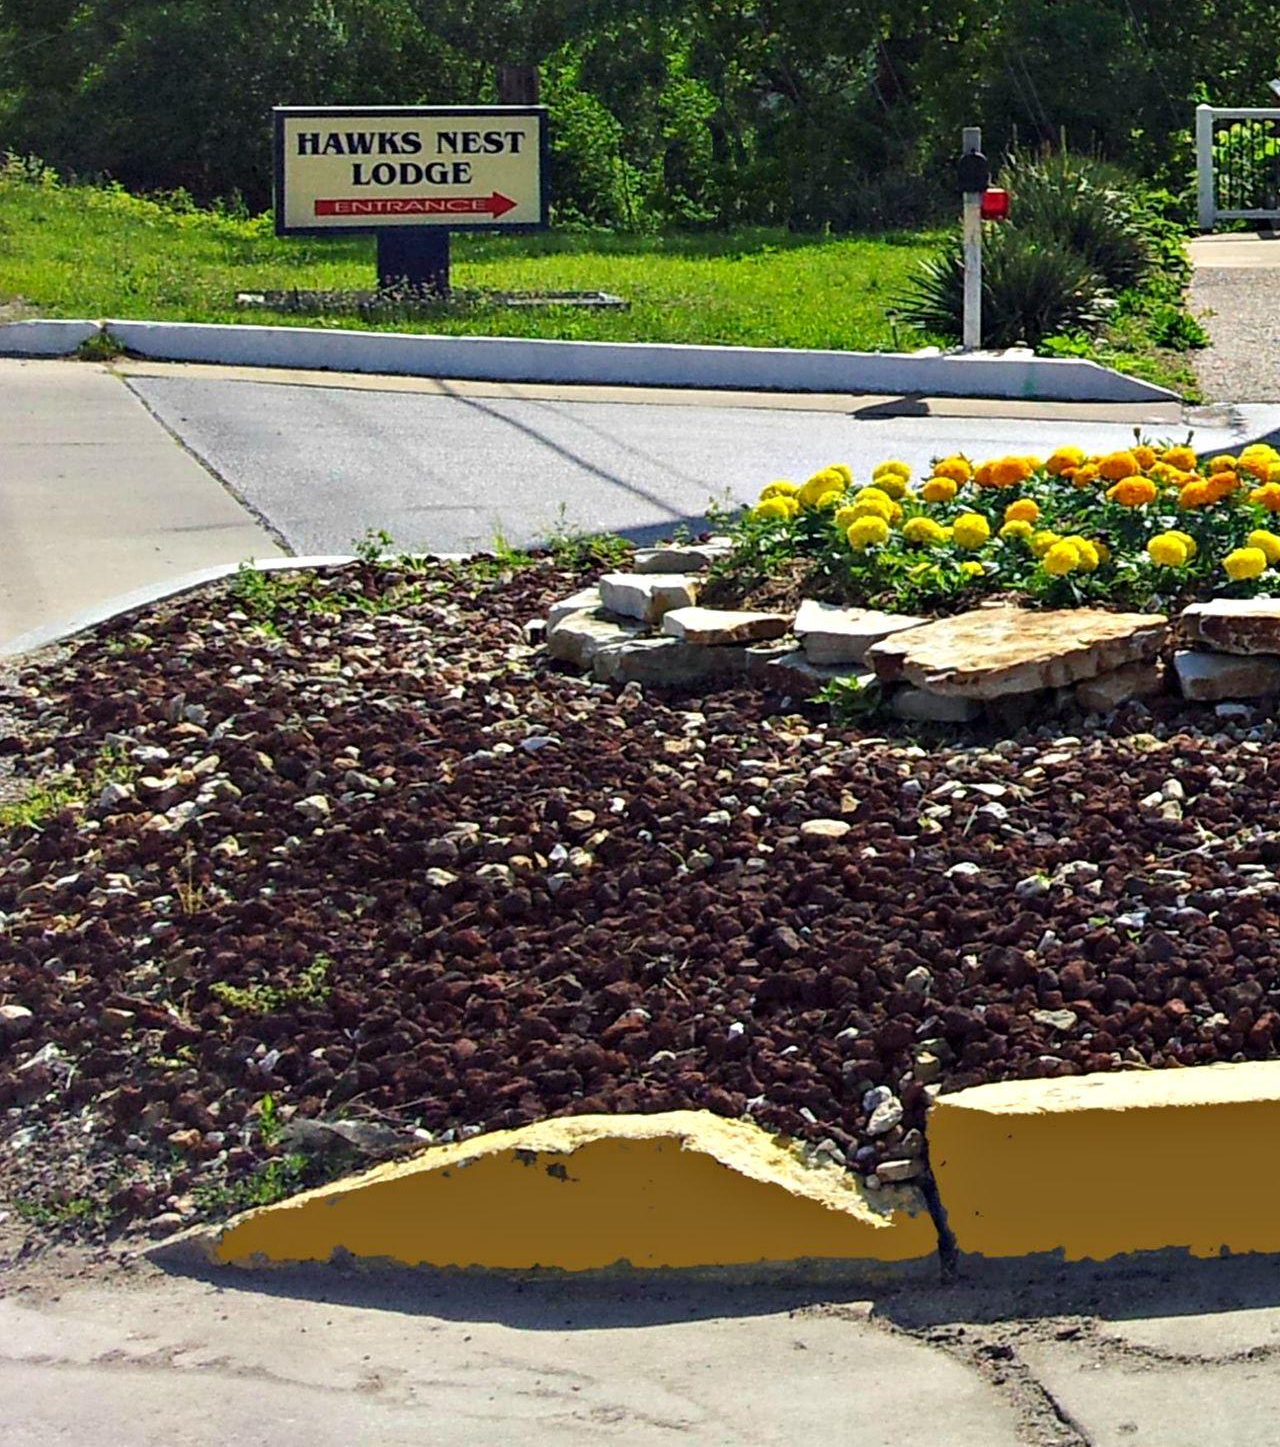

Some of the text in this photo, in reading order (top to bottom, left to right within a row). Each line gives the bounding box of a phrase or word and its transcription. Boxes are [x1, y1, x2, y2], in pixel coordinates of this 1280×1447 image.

[297, 131, 526, 155] HAWKS NEST
[352, 162, 472, 186] LODGE
[334, 199, 487, 213] ENTRANCE
